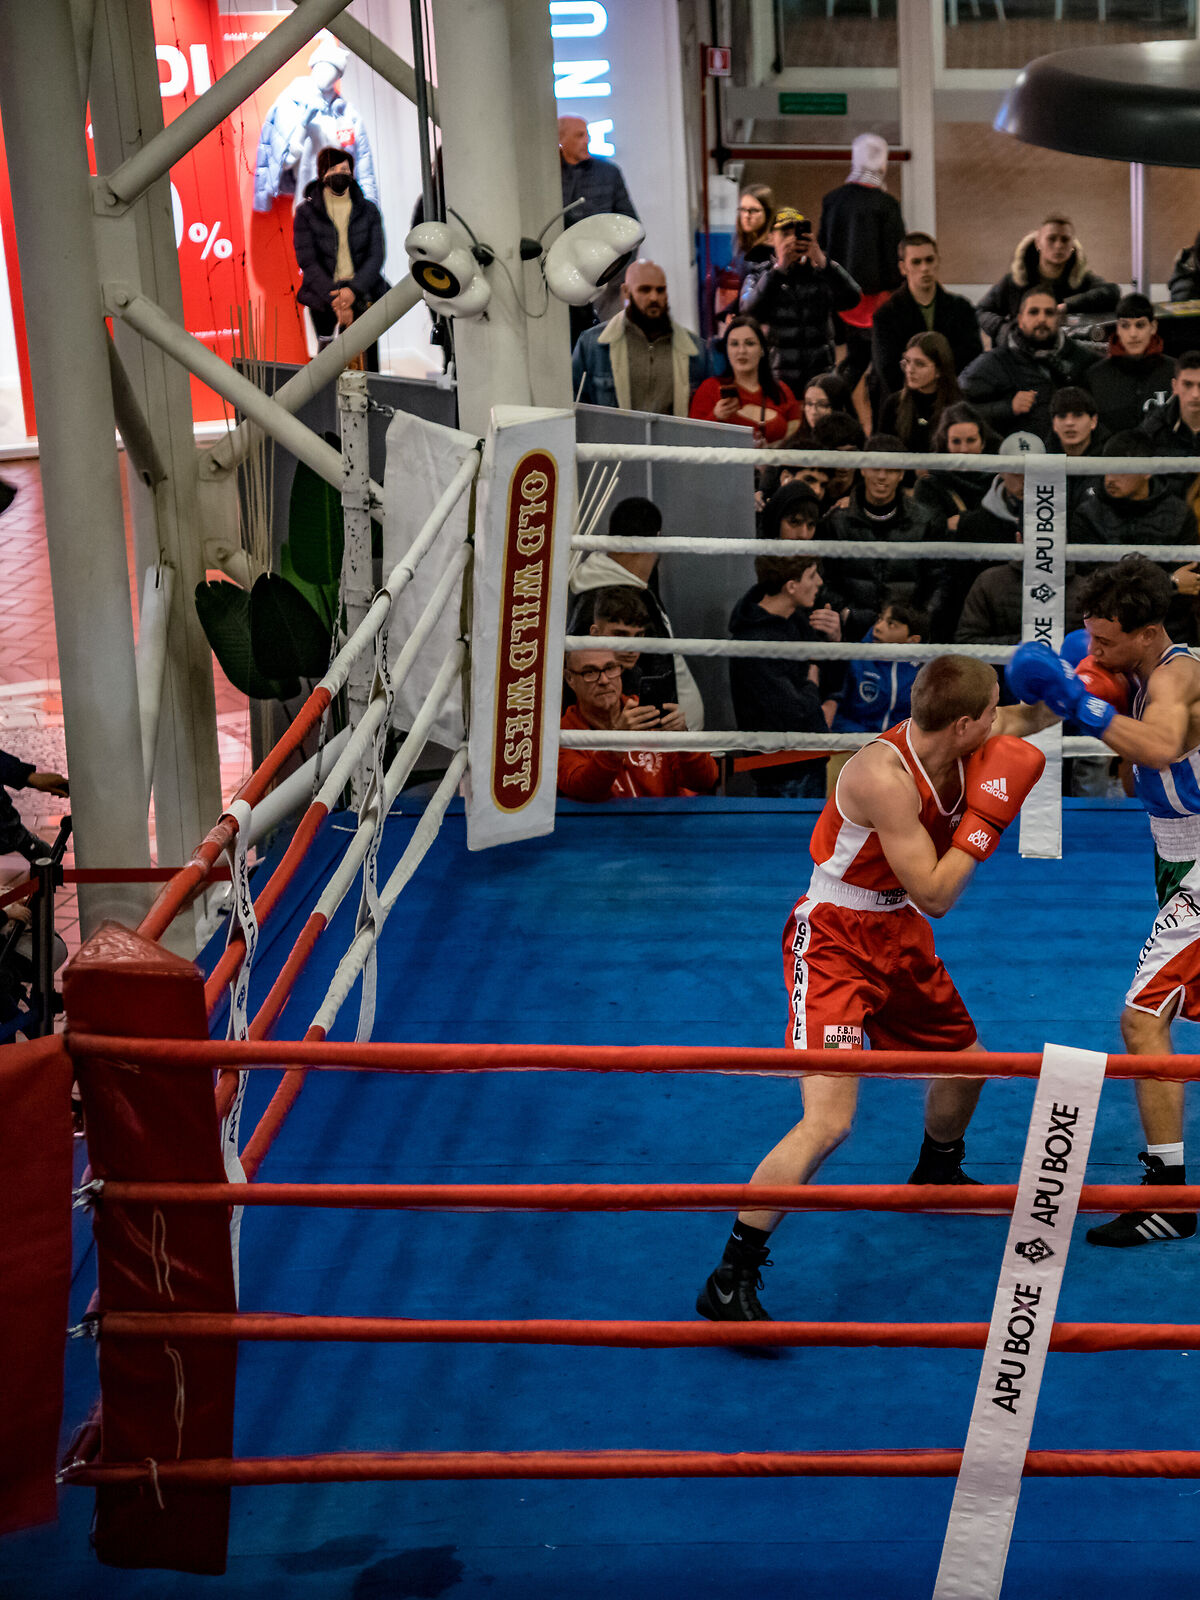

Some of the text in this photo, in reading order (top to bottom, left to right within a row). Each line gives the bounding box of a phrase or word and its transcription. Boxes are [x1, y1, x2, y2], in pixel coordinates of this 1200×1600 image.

[1035, 485, 1055, 574] APU BOXE
[502, 469, 549, 792] OLD WILD WEST
[1034, 617, 1053, 648] XE
[980, 782, 1009, 802] adidas
[975, 829, 992, 844] APU
[825, 1034, 861, 1045] CODROIPO
[1030, 1102, 1079, 1228] APU BOXE
[991, 1283, 1042, 1415] APU BOXE
